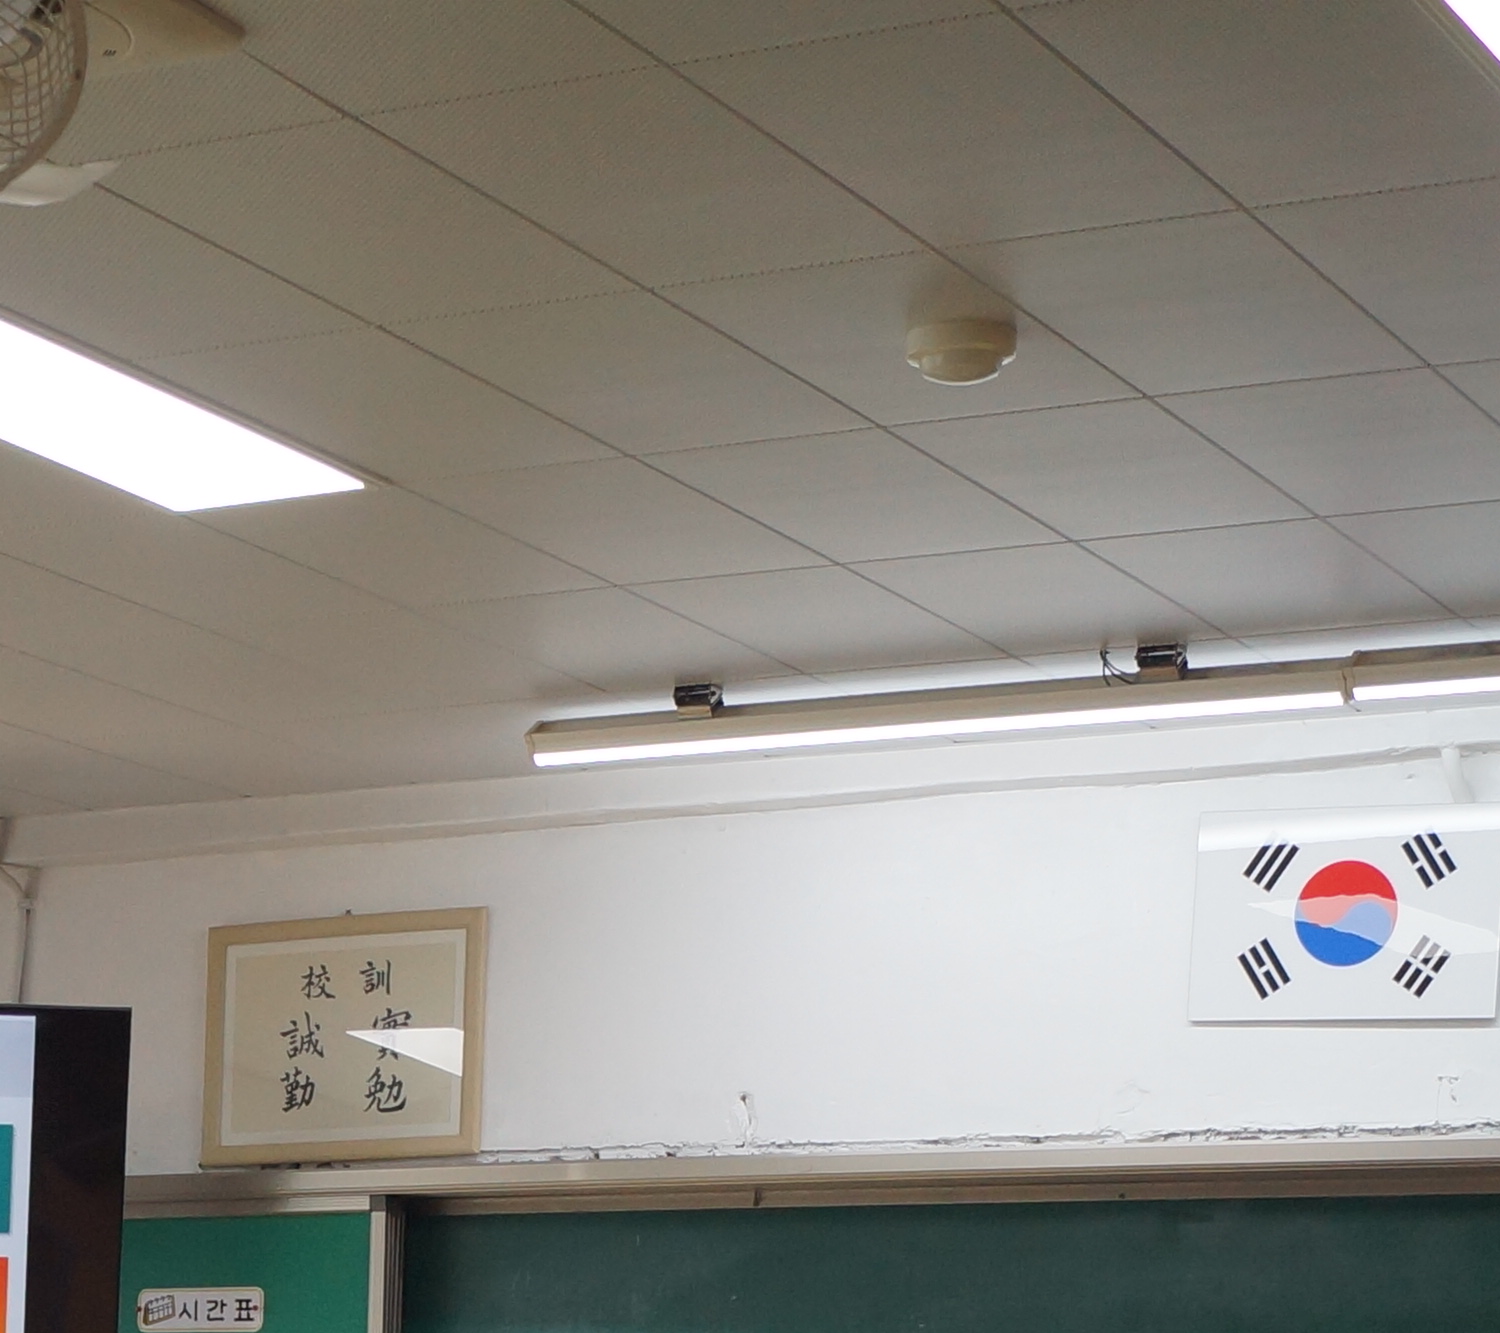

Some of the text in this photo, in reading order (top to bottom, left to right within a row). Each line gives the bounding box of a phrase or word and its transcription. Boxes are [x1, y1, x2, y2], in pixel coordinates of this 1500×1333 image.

[301, 960, 391, 1000] 校訓
[280, 1067, 407, 1113] 勤勉
[179, 1298, 255, 1322] 시간표
